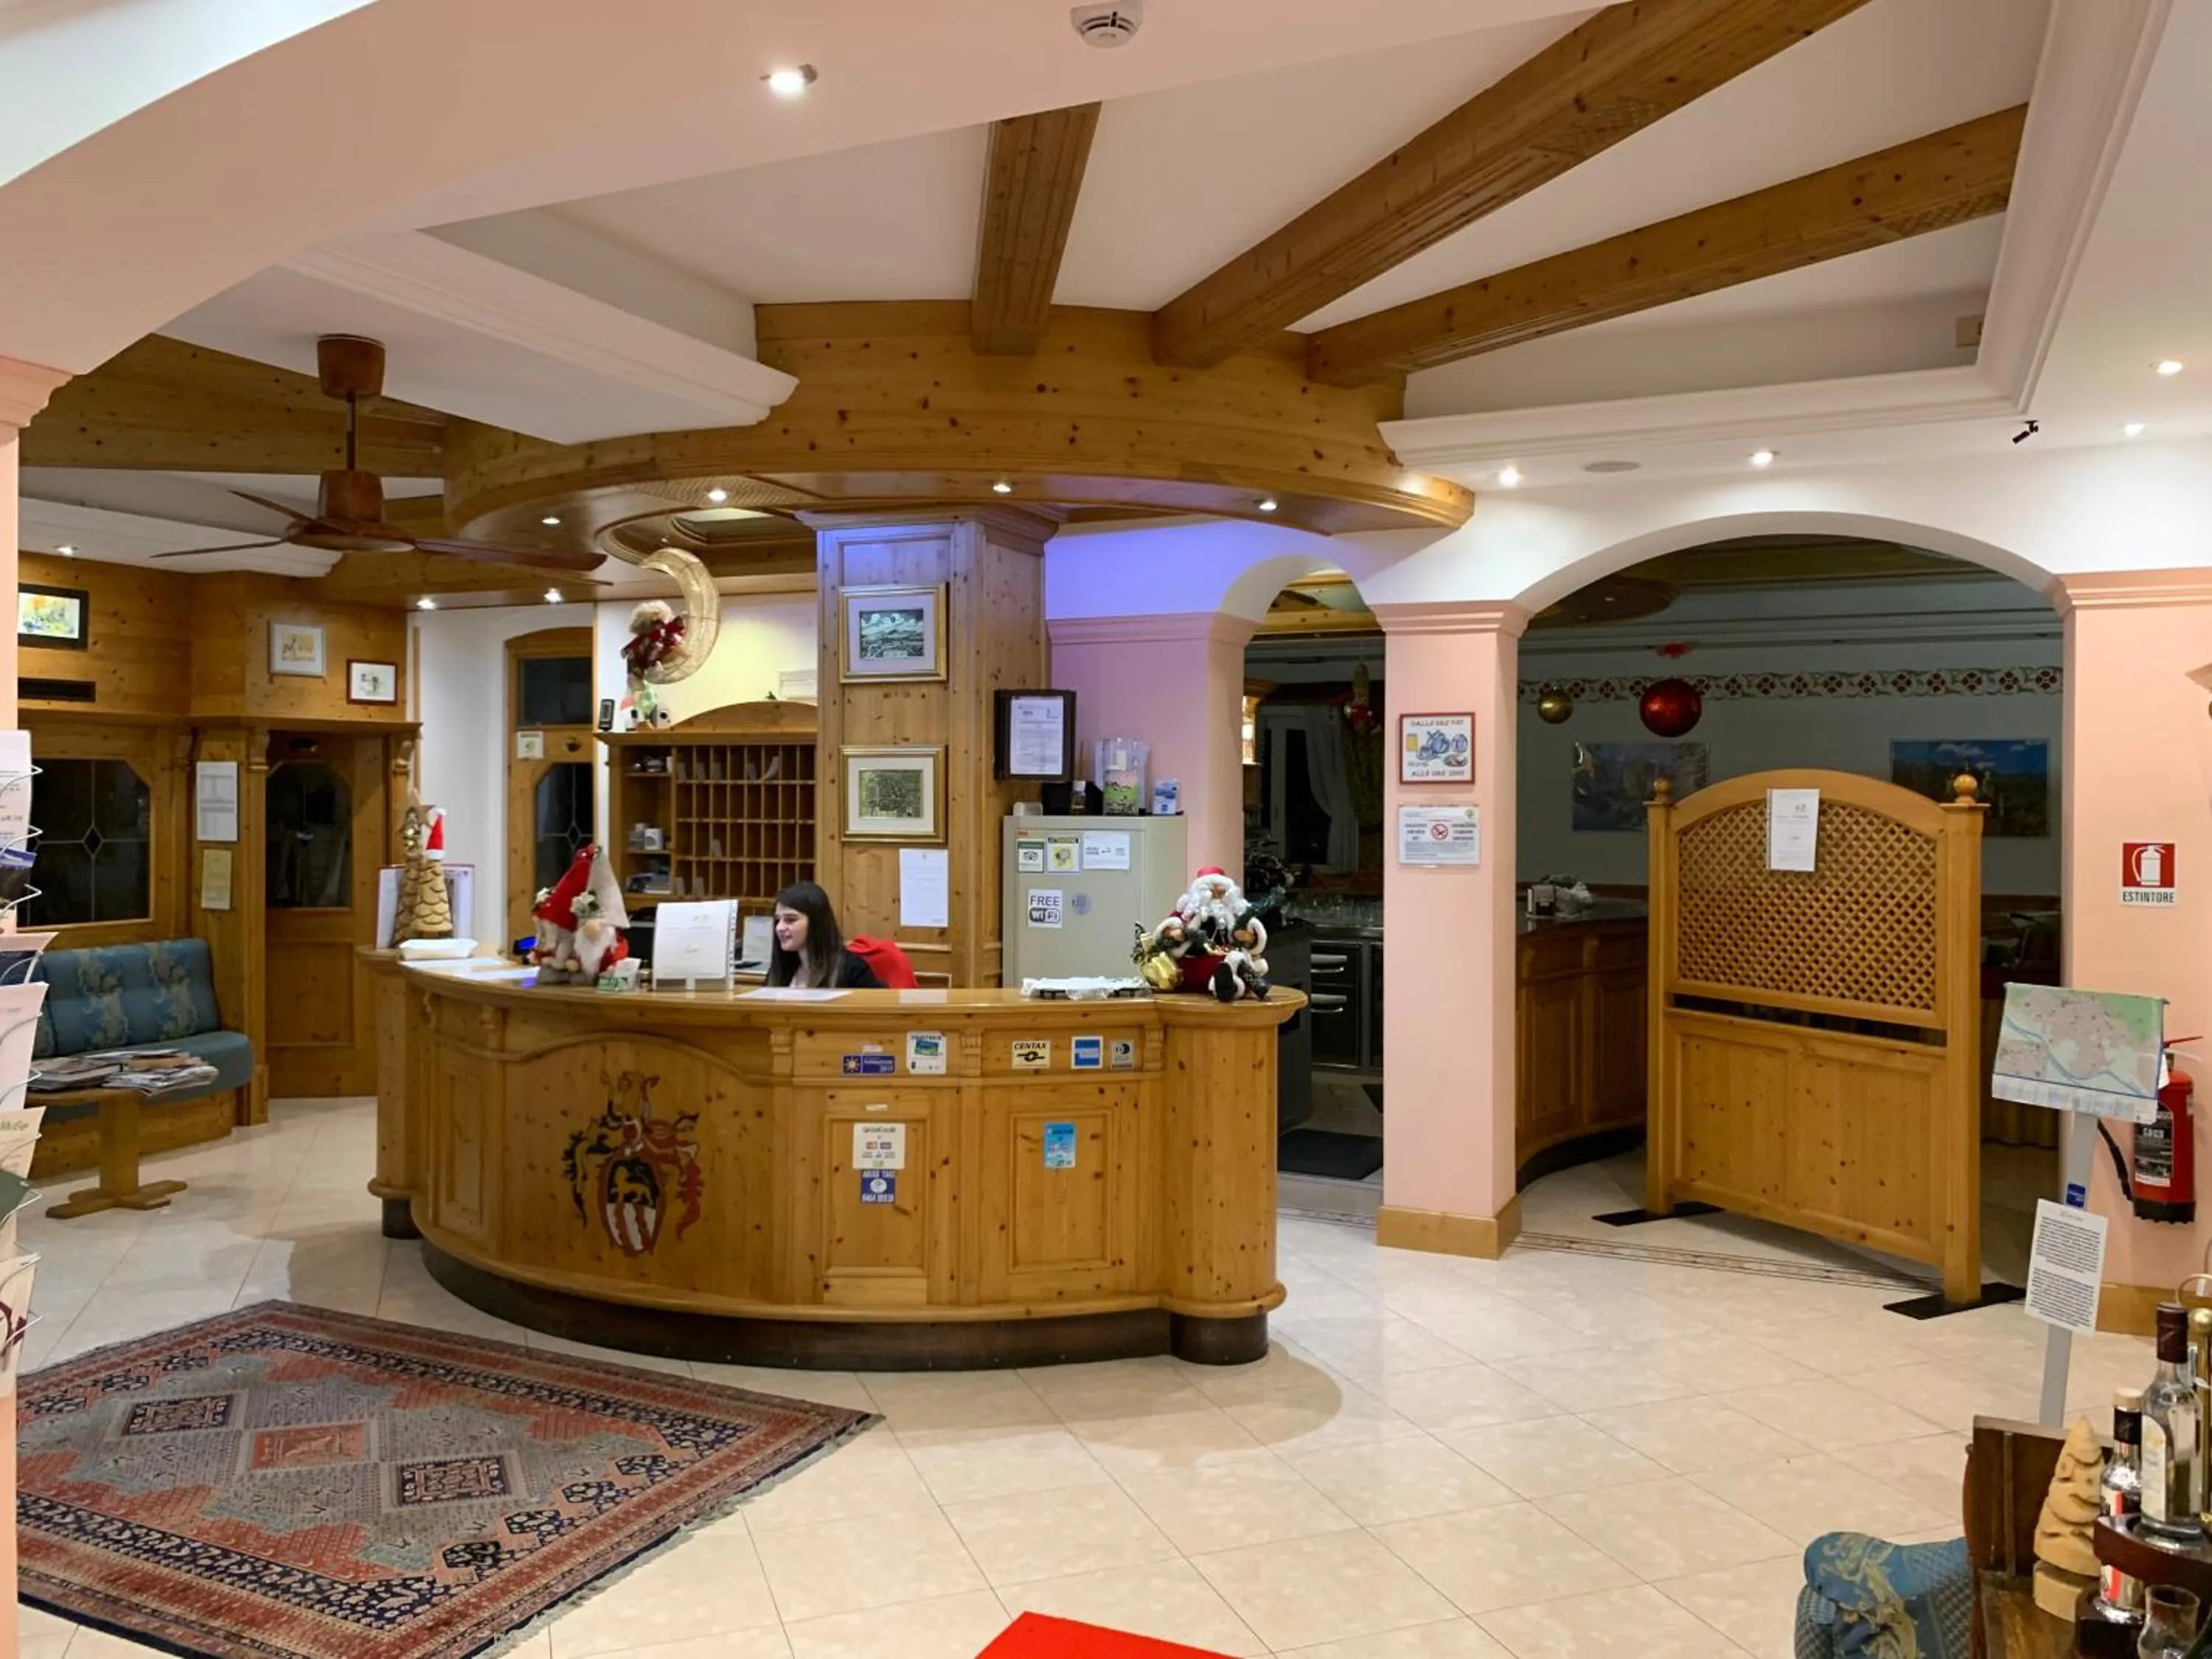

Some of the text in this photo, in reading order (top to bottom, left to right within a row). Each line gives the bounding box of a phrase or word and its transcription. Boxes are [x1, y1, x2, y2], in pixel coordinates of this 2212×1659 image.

[1030, 895, 1060, 906] FREE
[2123, 891, 2176, 903] ESTINTORE
[1014, 1042, 1046, 1051] CENTAX
